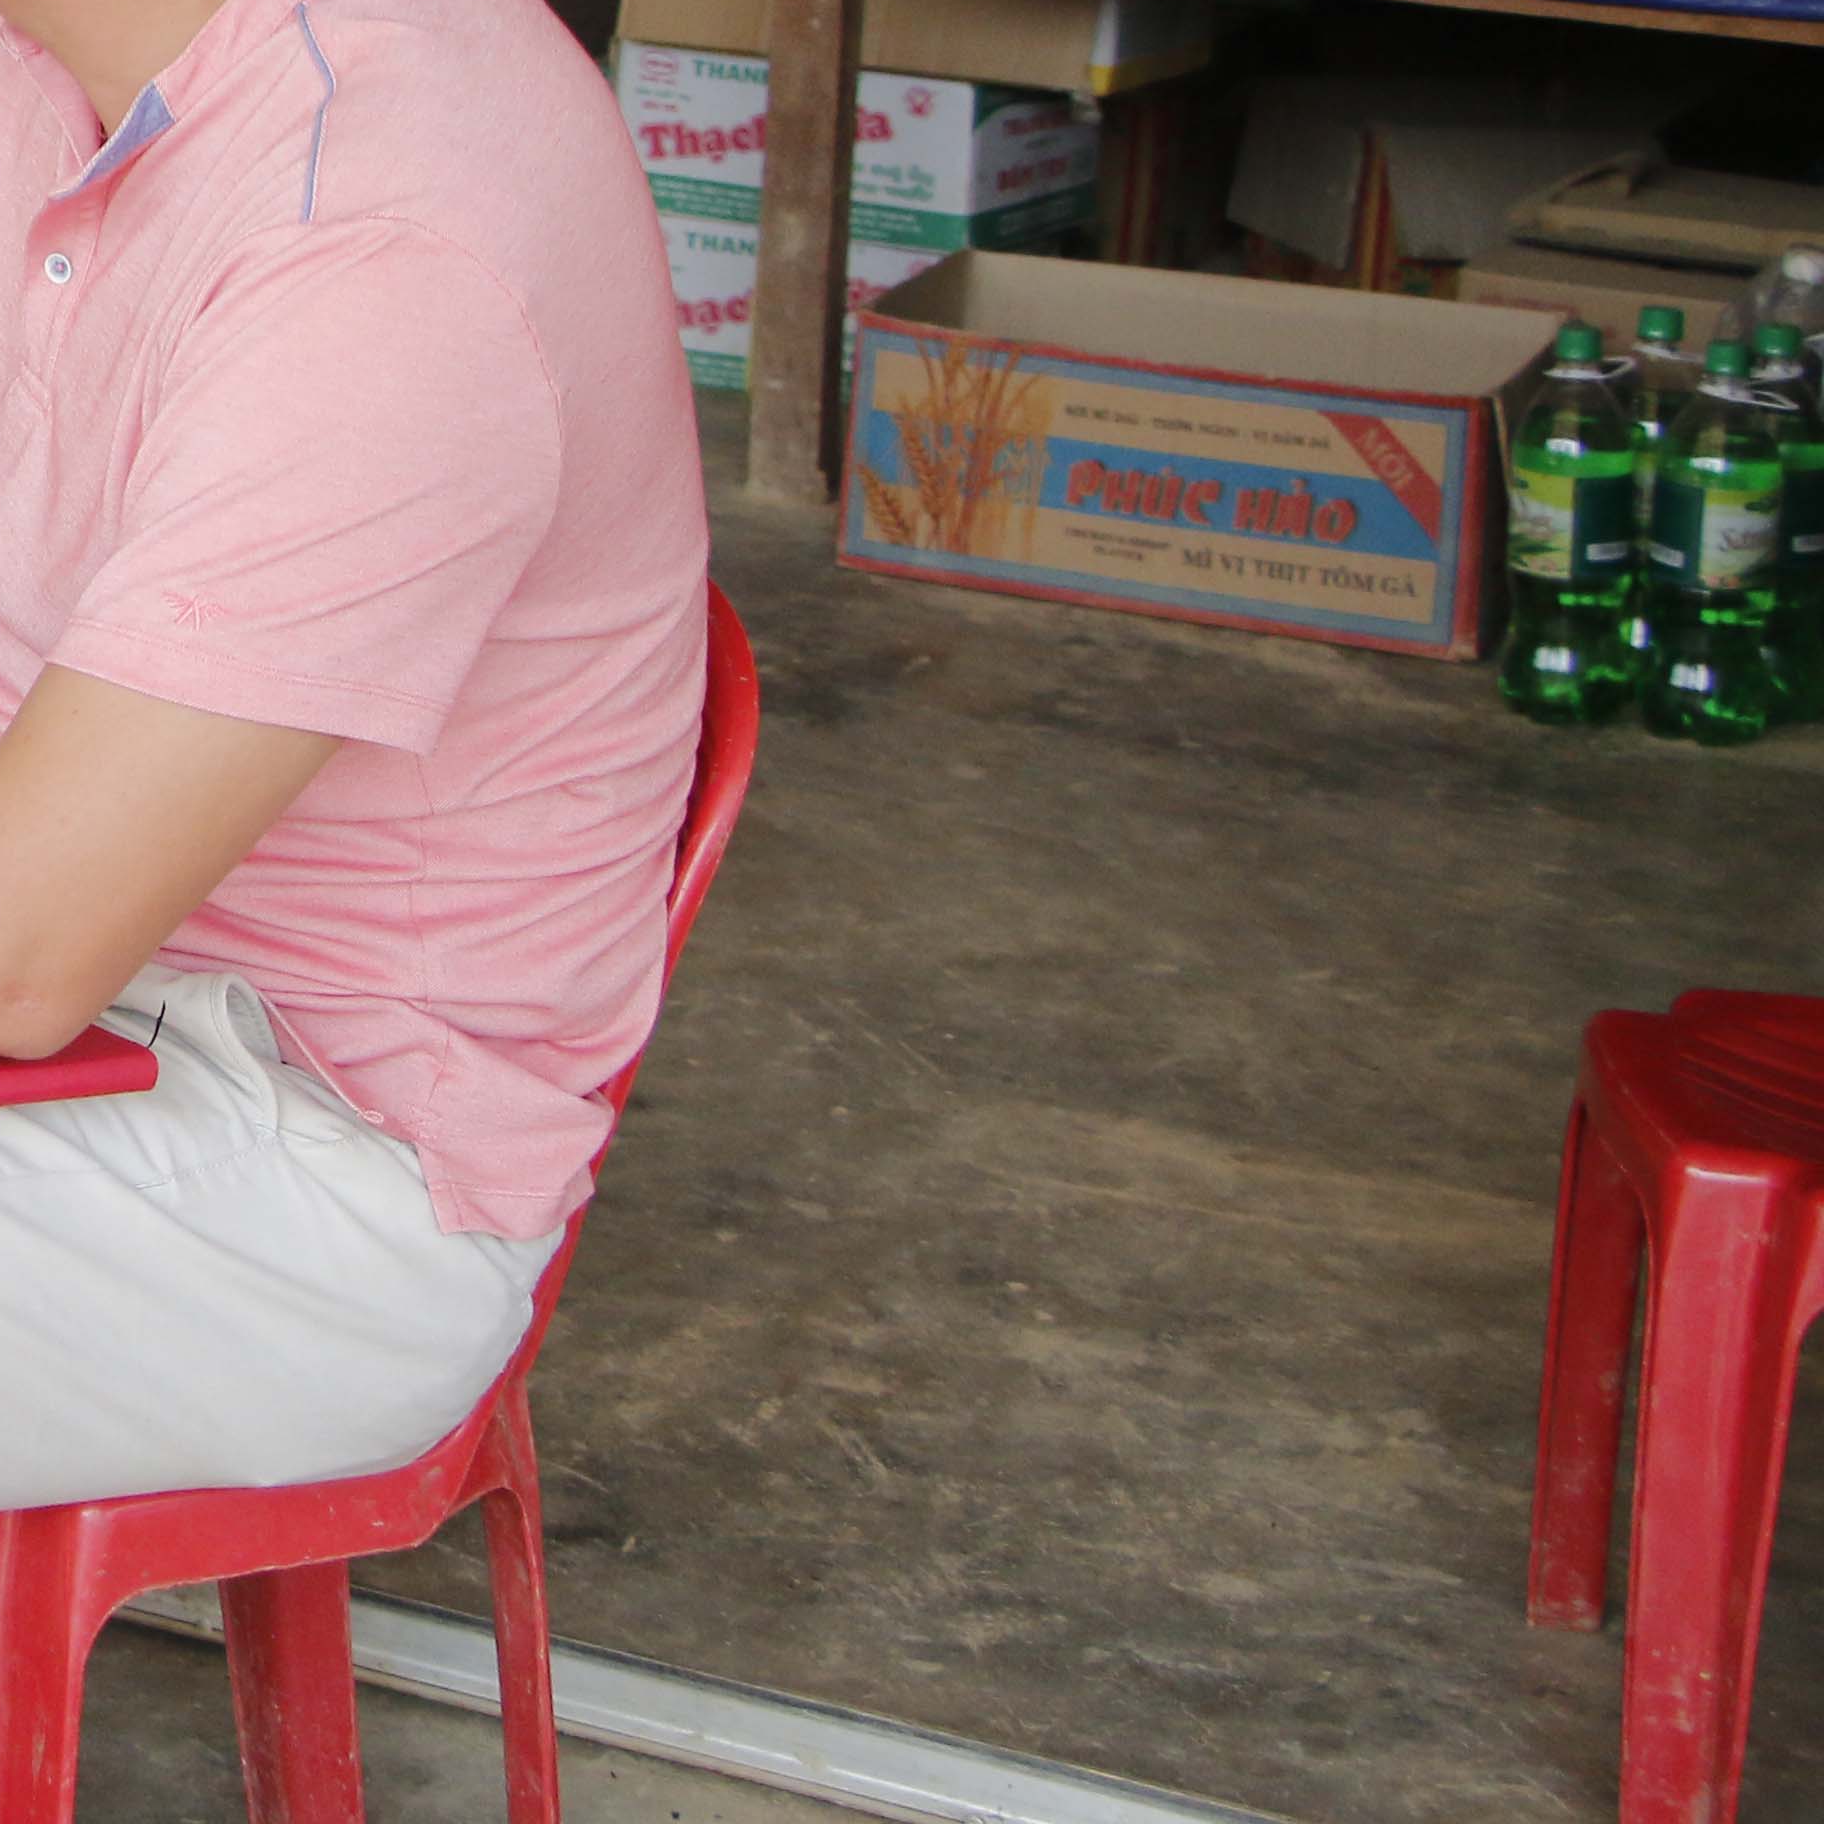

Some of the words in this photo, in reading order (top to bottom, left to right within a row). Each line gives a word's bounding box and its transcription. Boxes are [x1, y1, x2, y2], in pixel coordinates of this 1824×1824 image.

[687, 231, 756, 256] THAN
[1064, 458, 1222, 527] PHÚC
[1232, 478, 1358, 545] HẢO
